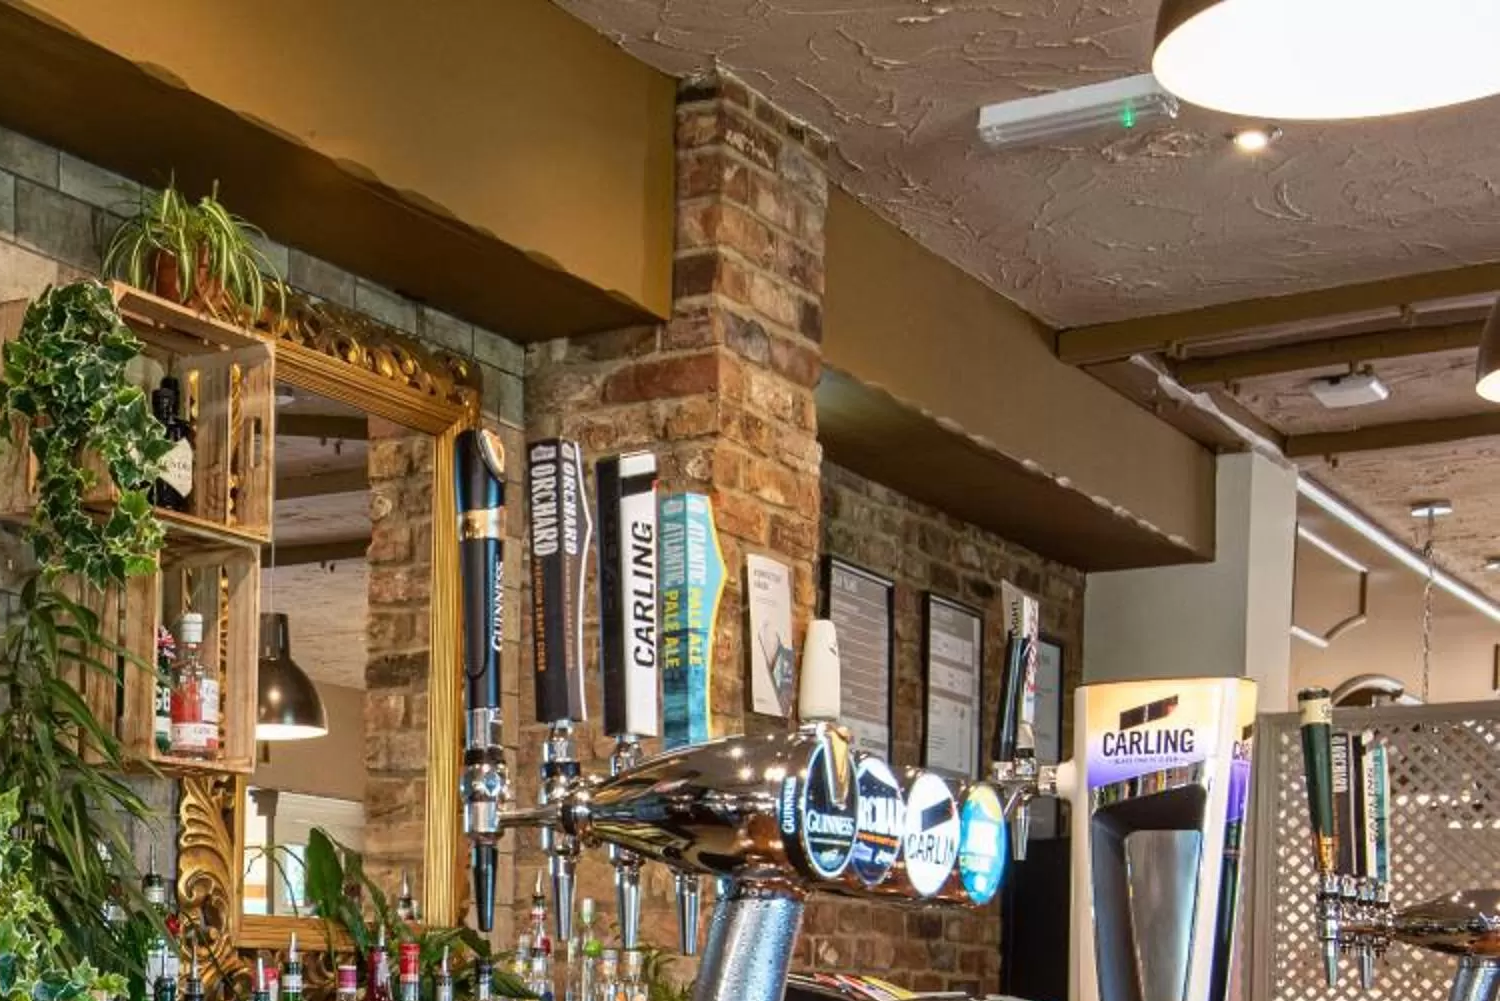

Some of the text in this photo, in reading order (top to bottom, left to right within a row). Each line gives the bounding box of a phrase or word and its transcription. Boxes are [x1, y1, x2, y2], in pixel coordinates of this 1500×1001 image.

[531, 463, 559, 557] ORCHARD
[562, 461, 578, 556] ORCHARD
[490, 561, 504, 652] GUINNESS
[631, 520, 655, 669] CARLING
[664, 589, 680, 634] PALE
[664, 636, 680, 668] ALE
[1102, 727, 1195, 757] CARLING
